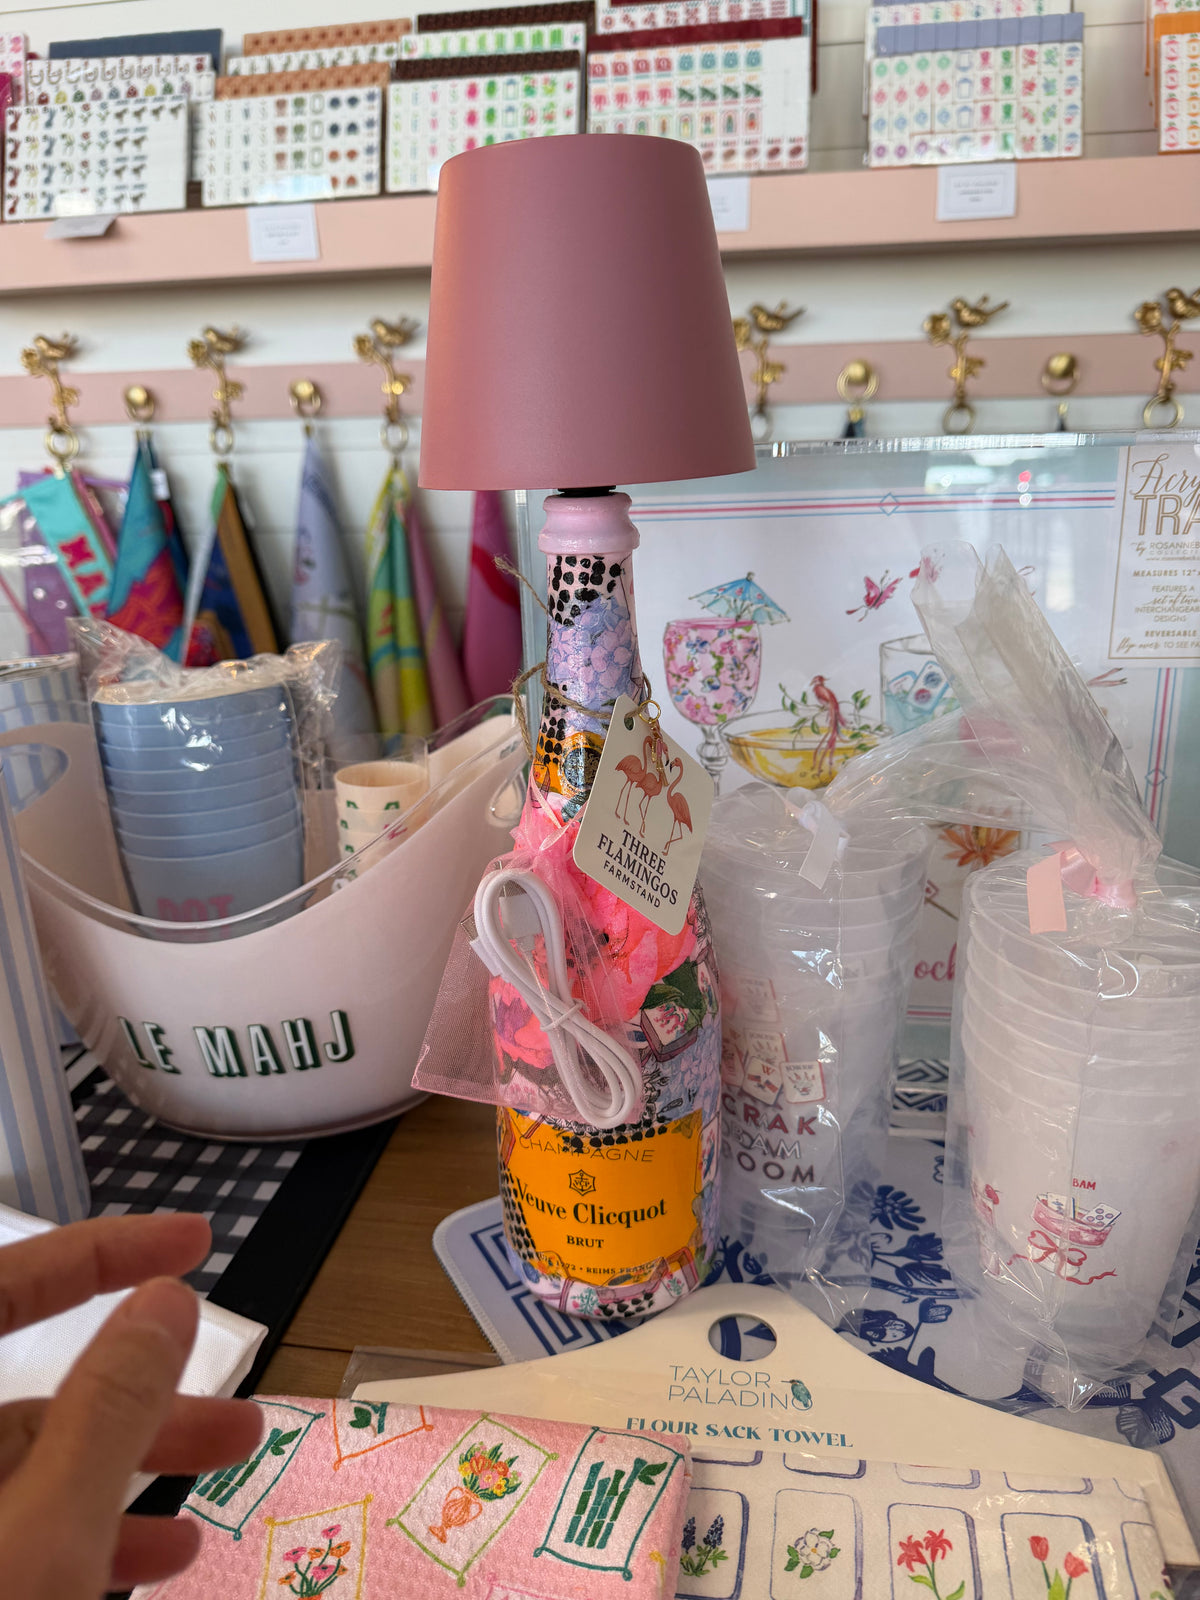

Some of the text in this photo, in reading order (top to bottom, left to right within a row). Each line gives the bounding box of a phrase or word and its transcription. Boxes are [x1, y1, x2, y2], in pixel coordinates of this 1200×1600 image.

[597, 833, 679, 905] FLAMINGOS
[622, 829, 666, 876] THREE
[603, 860, 661, 908] FARMSTAND
[118, 1009, 355, 1077] LE MAHJ
[721, 1092, 817, 1135] CRAK
[514, 1176, 667, 1228] Veuve Clicquot
[1072, 1178, 1096, 1190] BAM
[566, 1235, 604, 1248] BRUT
[668, 1385, 813, 1411] PALADINO
[669, 1365, 771, 1388] TAYLOR
[705, 1423, 762, 1440] SACK
[768, 1427, 854, 1448] TOWEL
